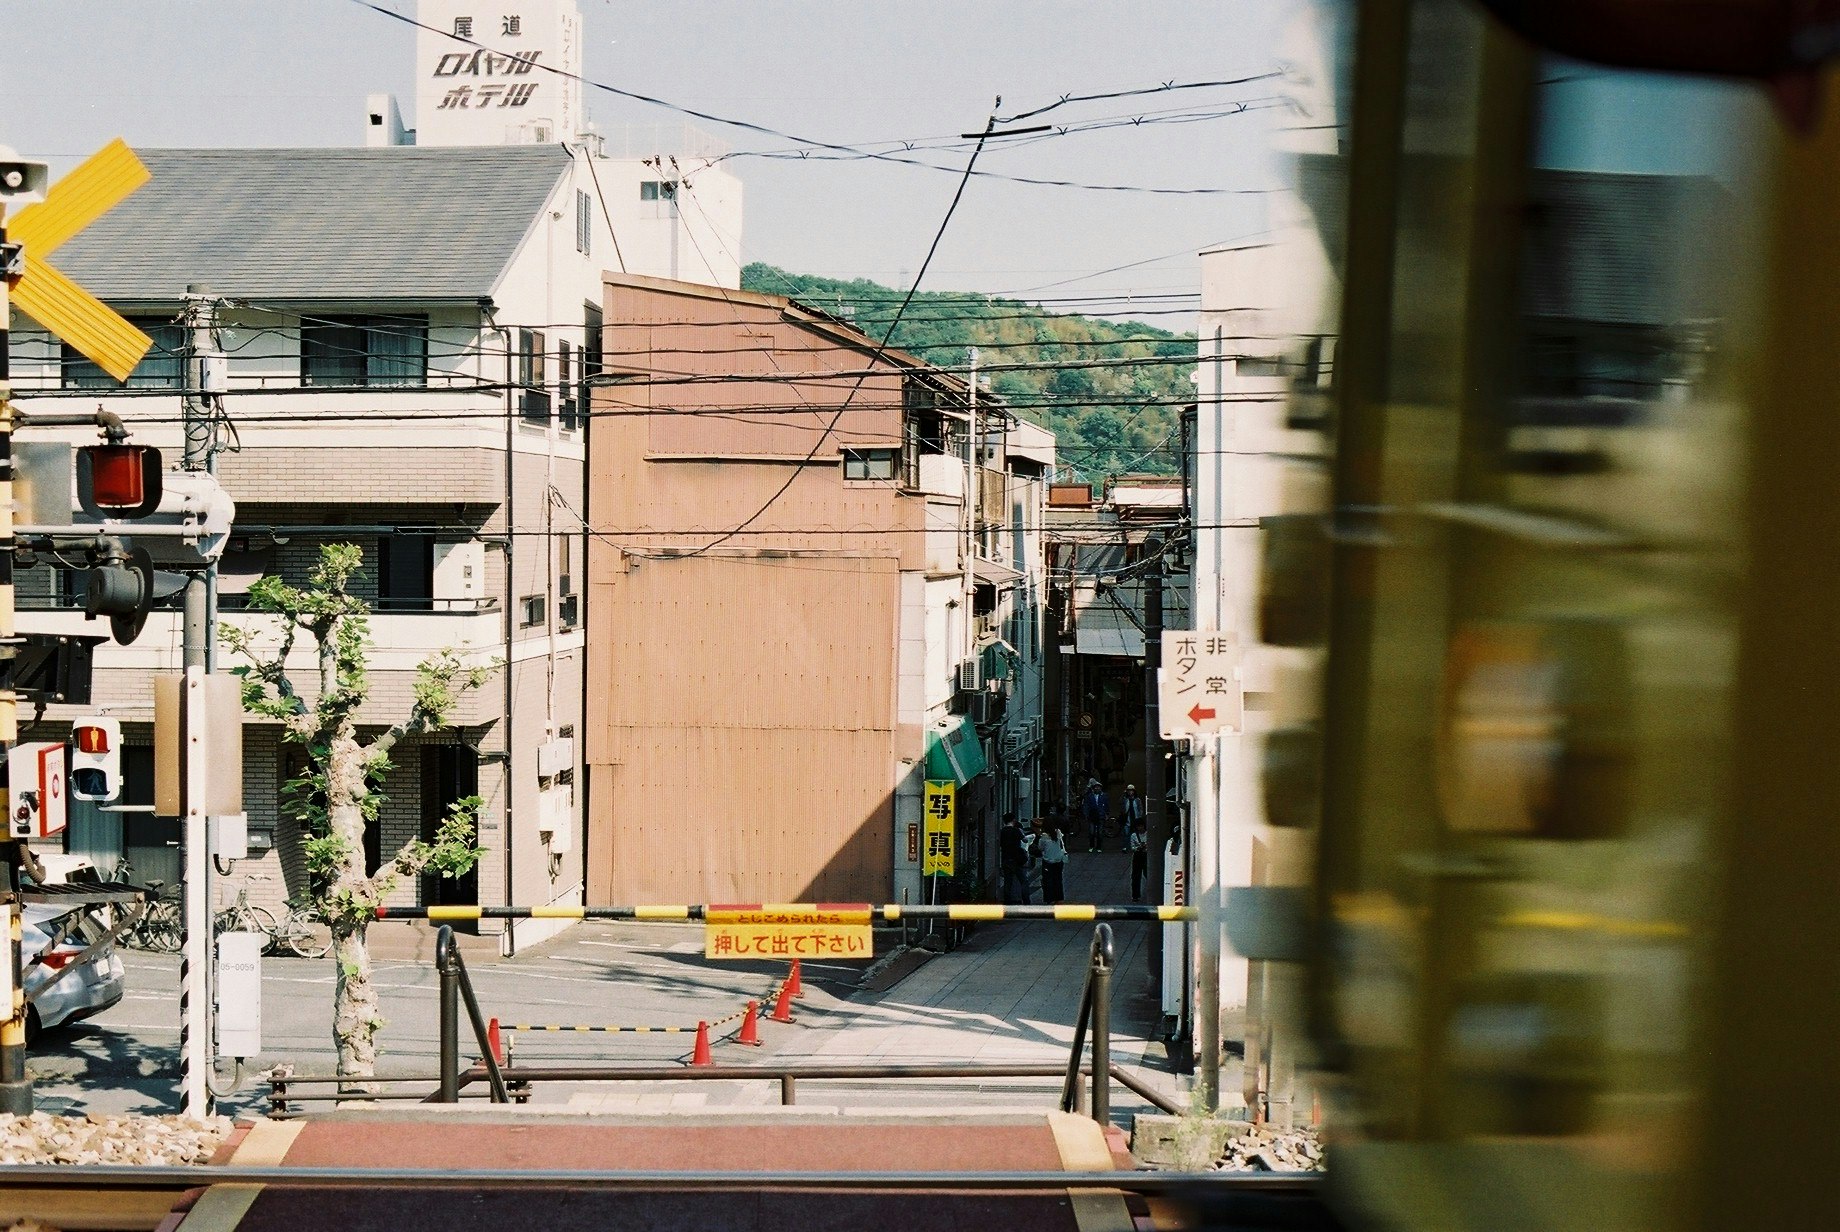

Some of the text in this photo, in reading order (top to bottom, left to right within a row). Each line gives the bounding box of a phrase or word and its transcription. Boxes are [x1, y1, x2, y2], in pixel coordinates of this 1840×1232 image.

[453, 14, 522, 37] 尾道
[432, 49, 543, 77] ロイヤル
[436, 83, 539, 110] ホテル
[1176, 637, 1197, 695] ボタン
[1206, 637, 1227, 694] 非常
[929, 794, 951, 857] 写真
[714, 934, 865, 955] 押して出て下さい
[220, 963, 255, 971] 05-0059
